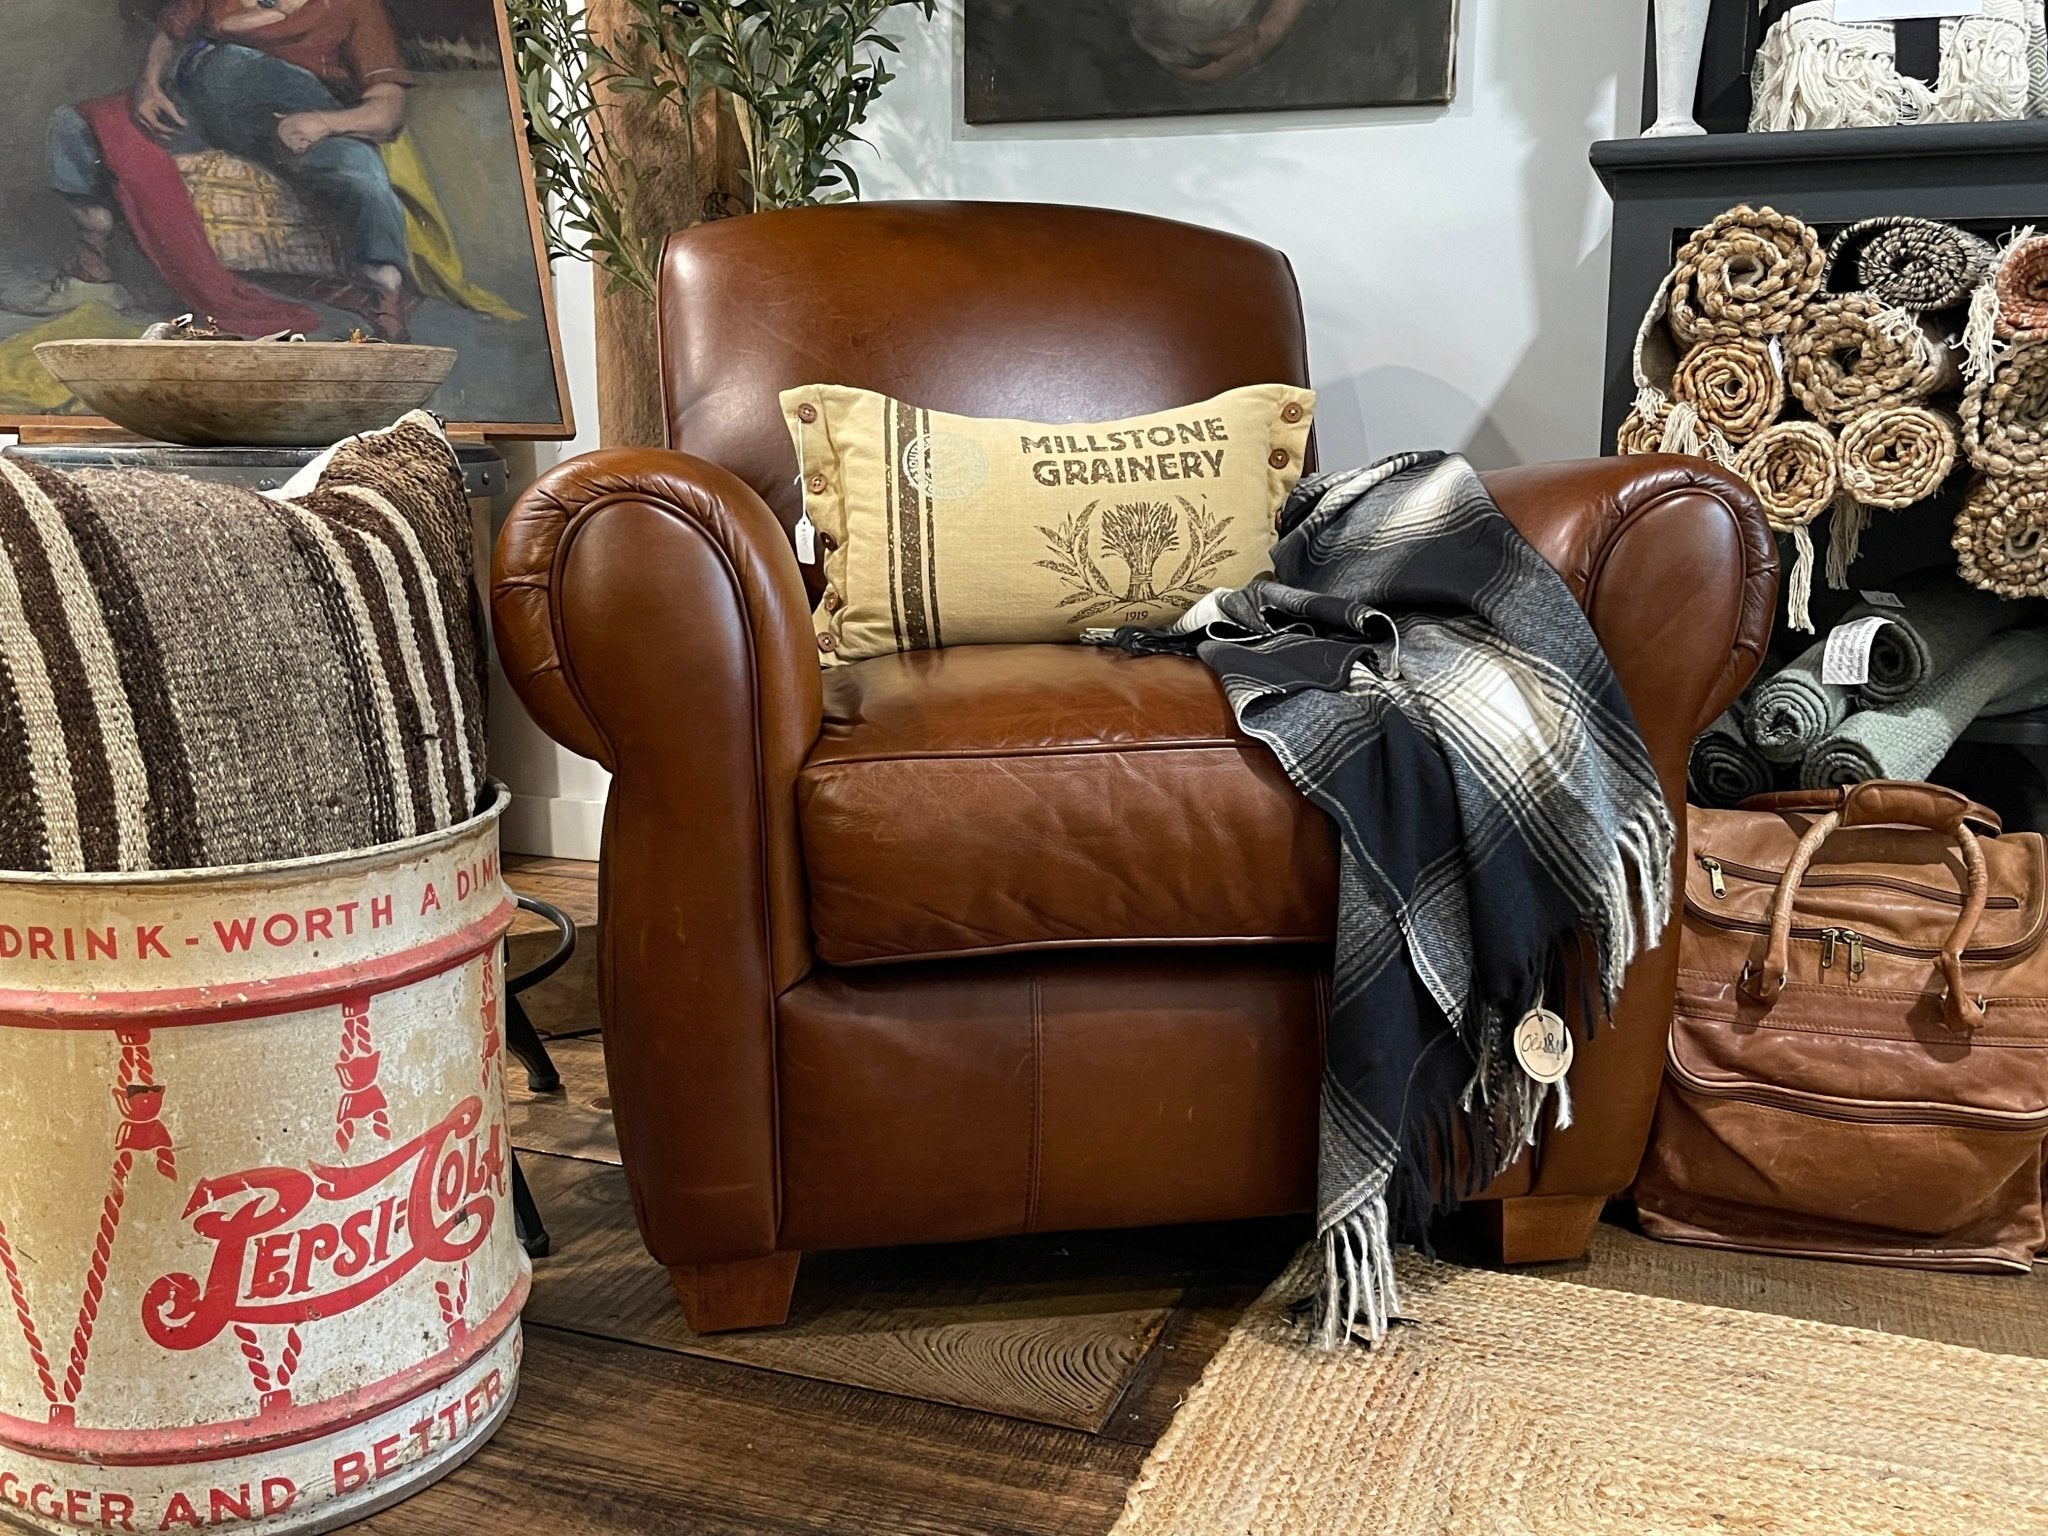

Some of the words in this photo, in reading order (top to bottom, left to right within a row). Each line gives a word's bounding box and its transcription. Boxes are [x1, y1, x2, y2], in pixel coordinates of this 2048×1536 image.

[1020, 417, 1229, 454] MILLSTONE
[1032, 449, 1225, 487] GRAINERY
[1125, 610, 1149, 622] 1919
[213, 894, 393, 953] WORTH
[420, 882, 441, 915] A
[0, 1471, 135, 1532] GGER
[159, 1476, 297, 1532] AND
[333, 1368, 501, 1497] BETTER
